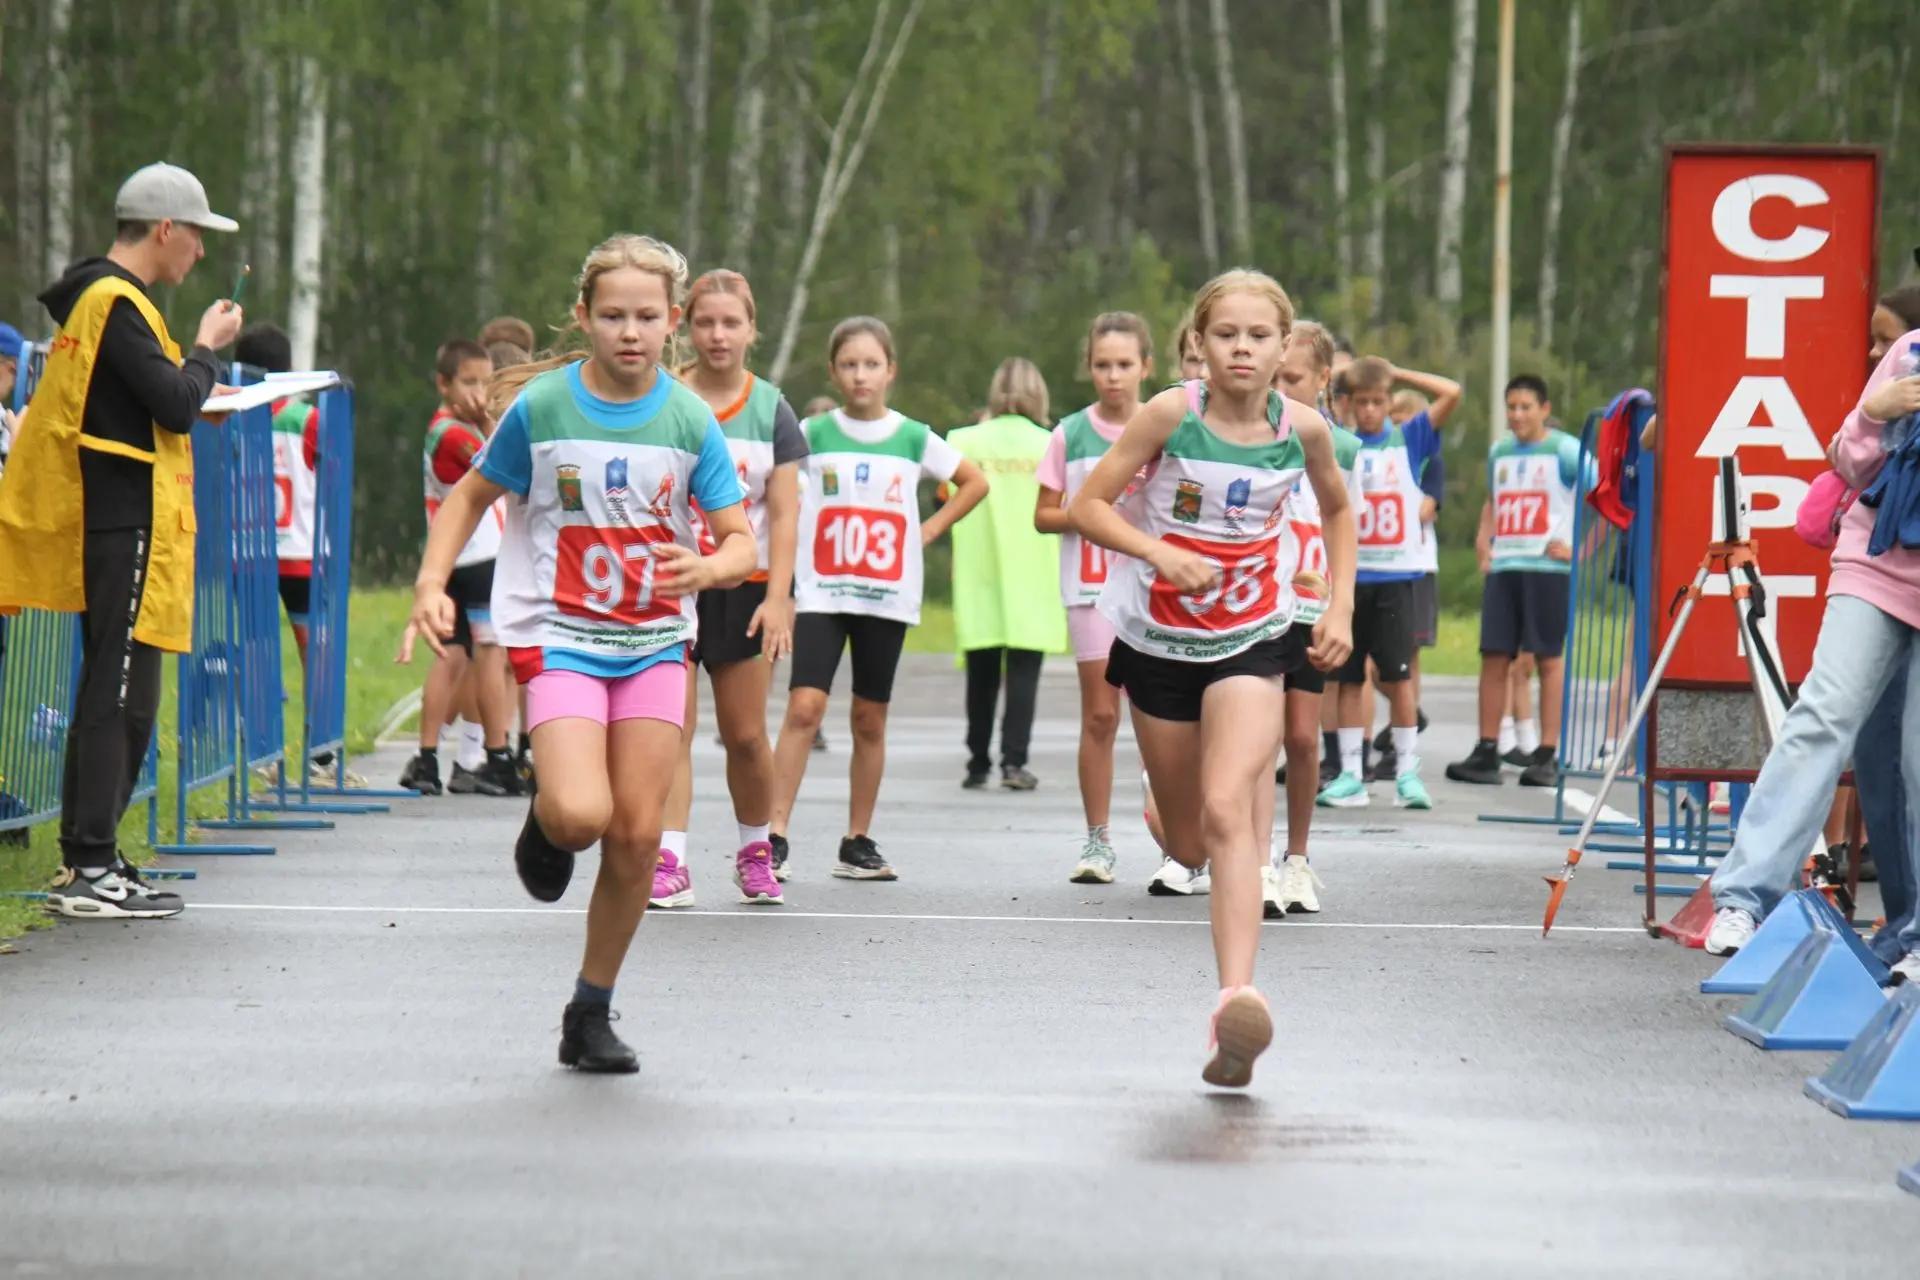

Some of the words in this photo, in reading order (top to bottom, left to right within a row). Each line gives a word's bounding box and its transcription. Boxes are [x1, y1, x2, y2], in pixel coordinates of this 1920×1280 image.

[1694, 174, 1831, 658] СТАРТ
[823, 514, 898, 572] 103
[1498, 496, 1542, 533] 117
[582, 542, 661, 615] 97
